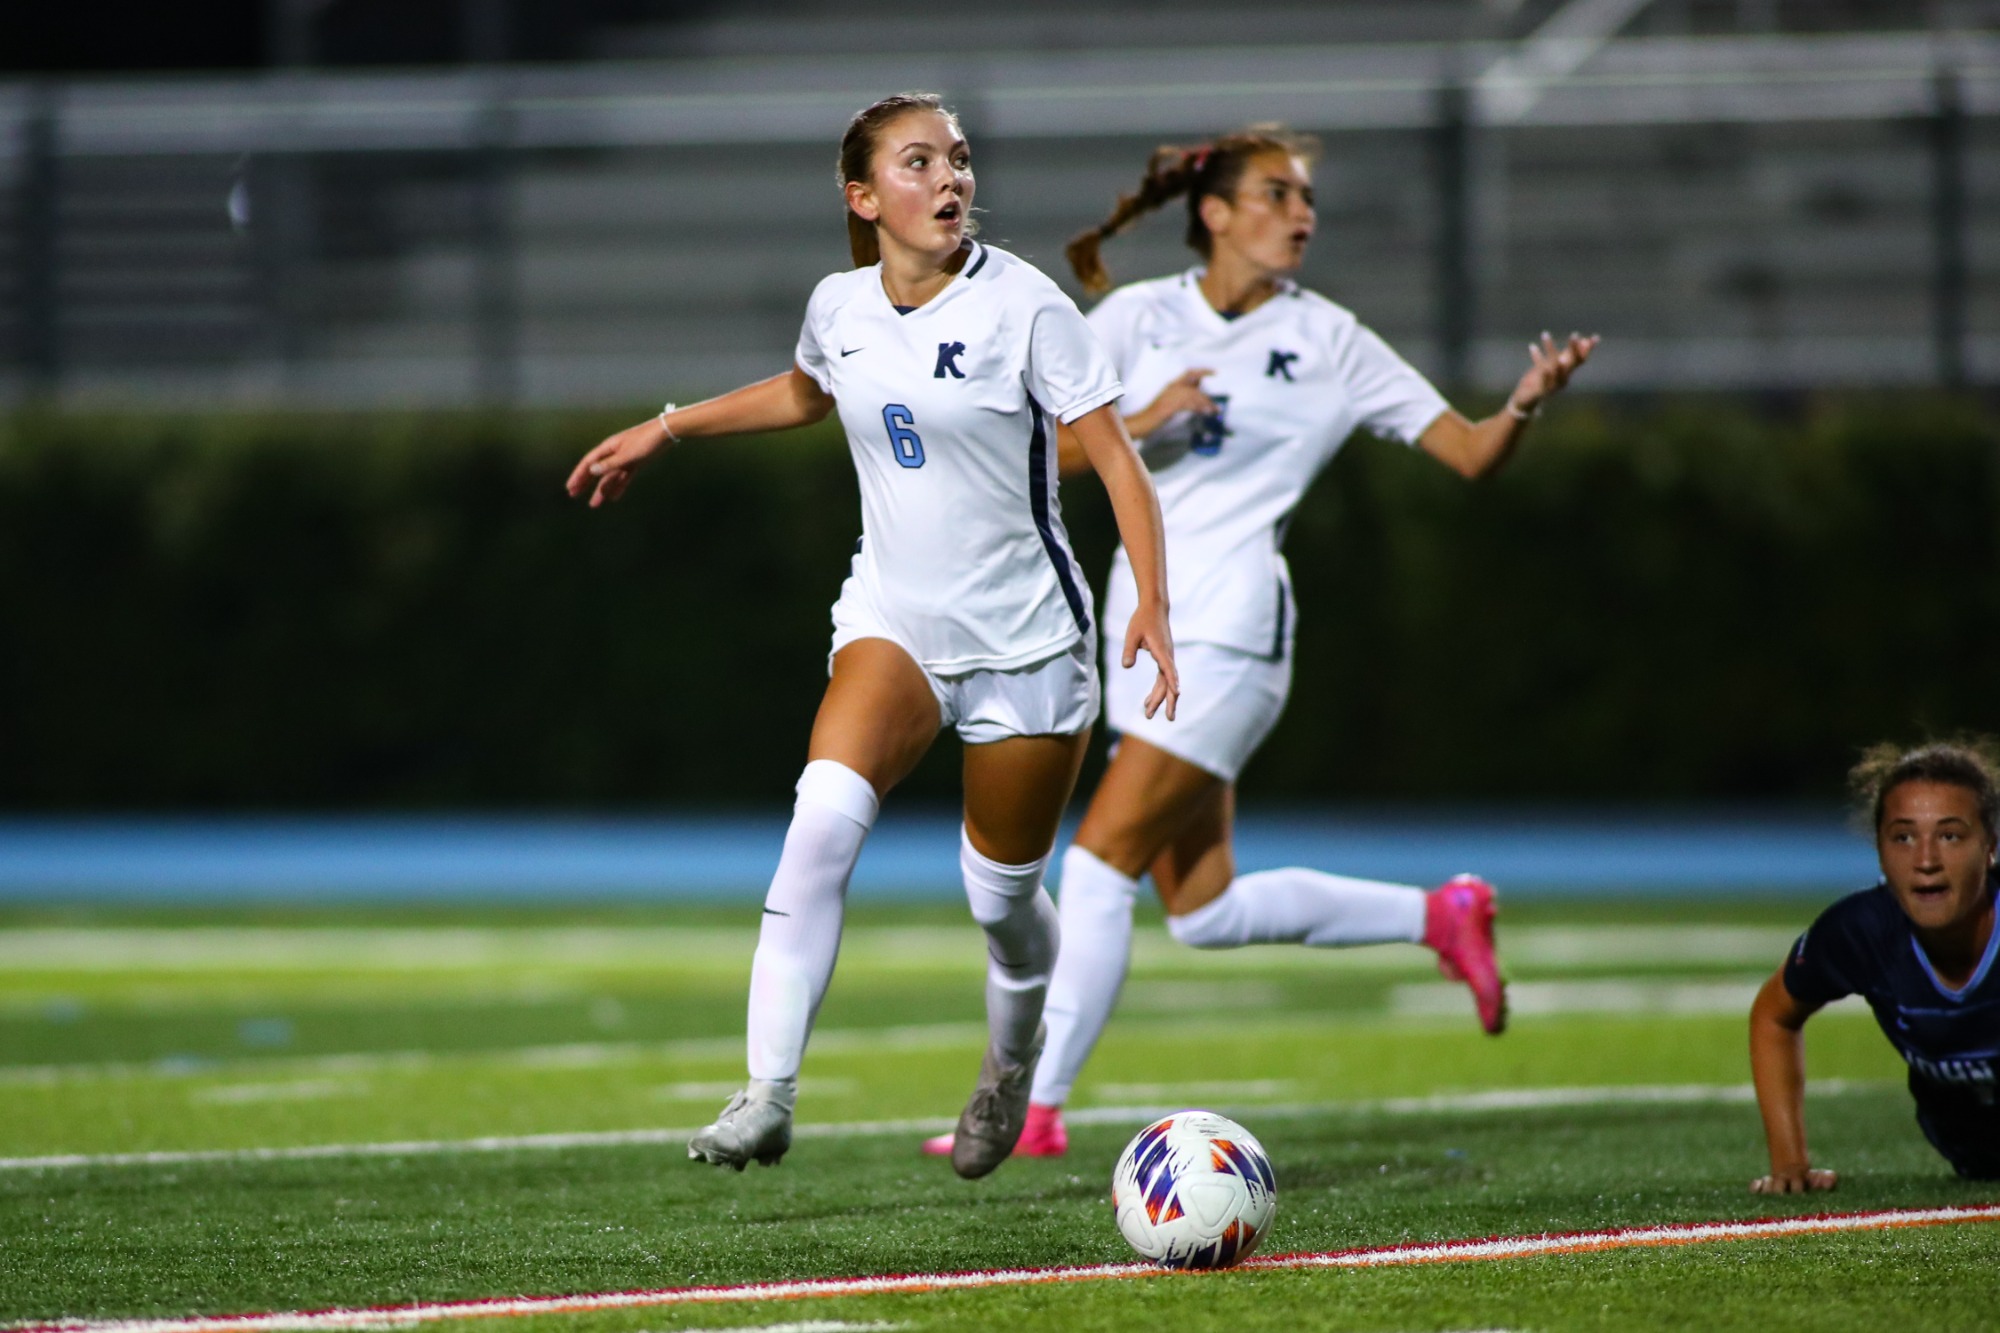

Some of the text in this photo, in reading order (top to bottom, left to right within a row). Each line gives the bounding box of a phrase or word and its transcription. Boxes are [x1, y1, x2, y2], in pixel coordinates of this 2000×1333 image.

[934, 341, 966, 379] K
[1265, 349, 1299, 383] K
[882, 403, 926, 468] 6
